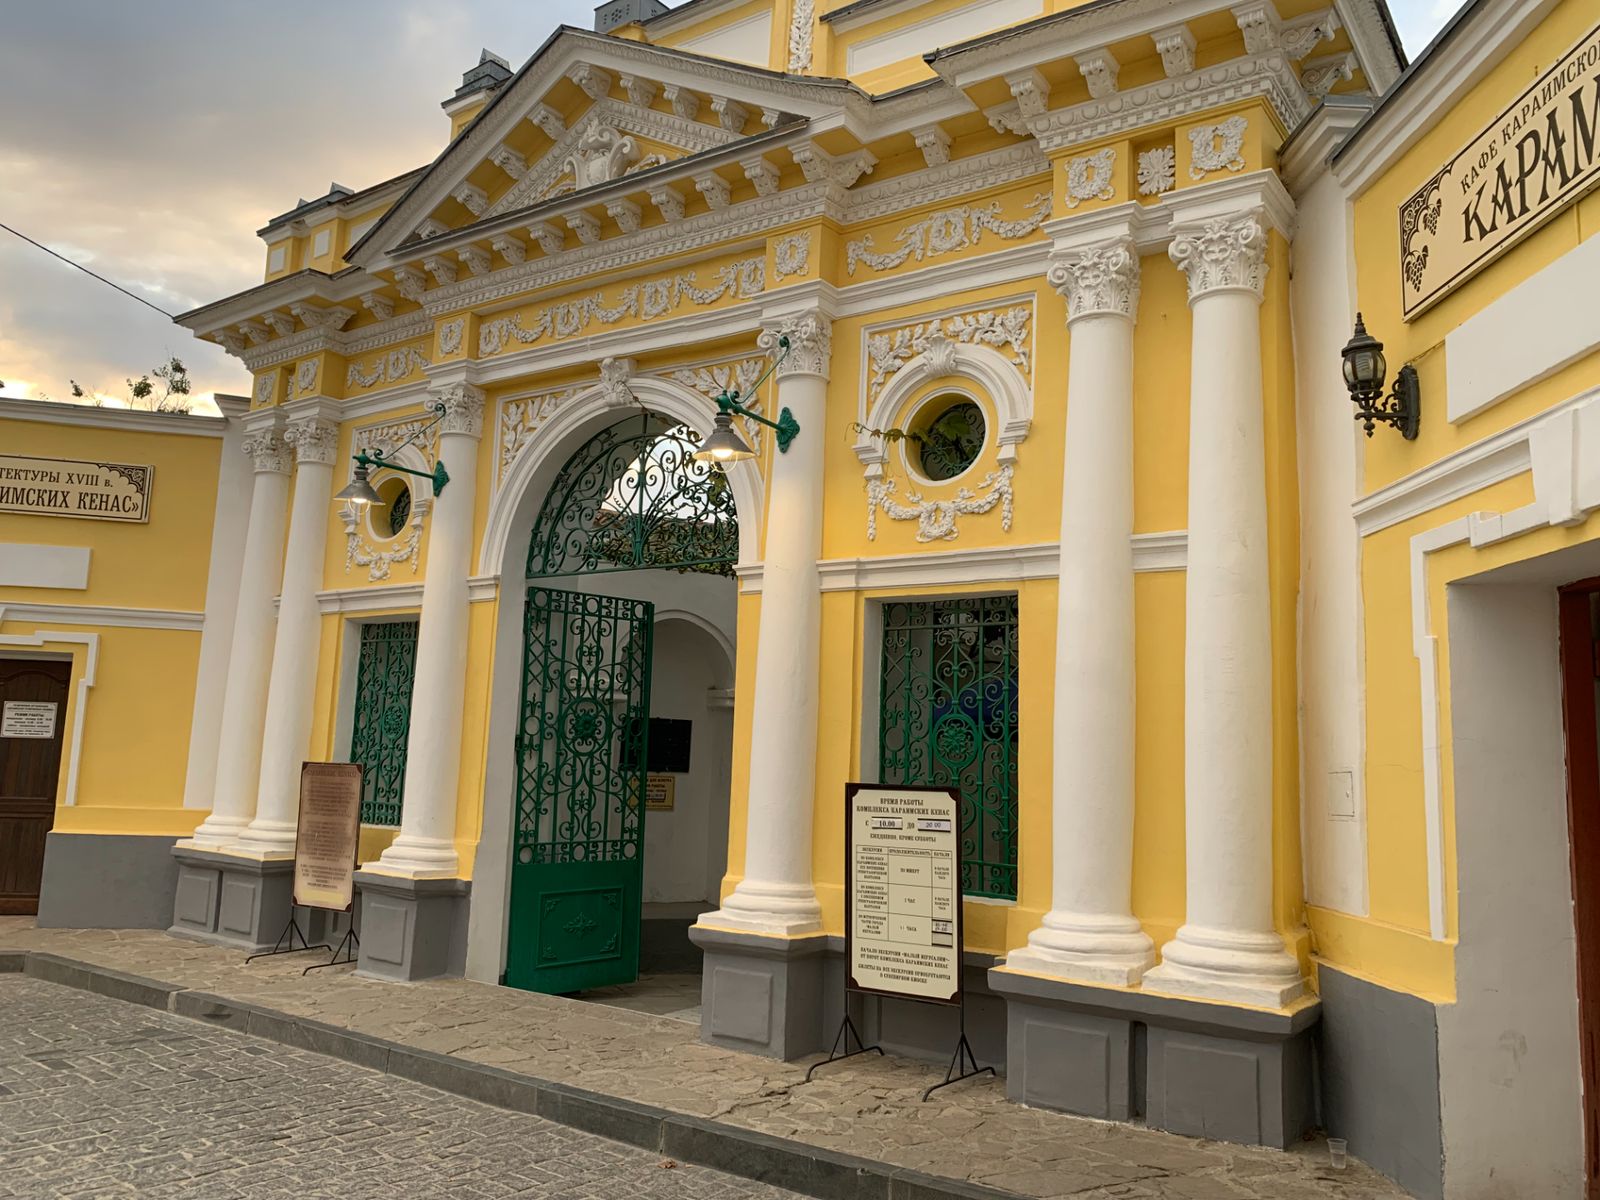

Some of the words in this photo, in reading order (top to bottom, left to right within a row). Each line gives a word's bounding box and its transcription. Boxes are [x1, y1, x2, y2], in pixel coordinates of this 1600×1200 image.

[1460, 140, 1498, 195] КАФЕ
[1502, 40, 1600, 141] КАРАИМСКО
[66, 473, 99, 486] XVIII
[76, 492, 139, 513] КЕНАС»
[891, 807, 929, 815] КАРАИМСКИХ
